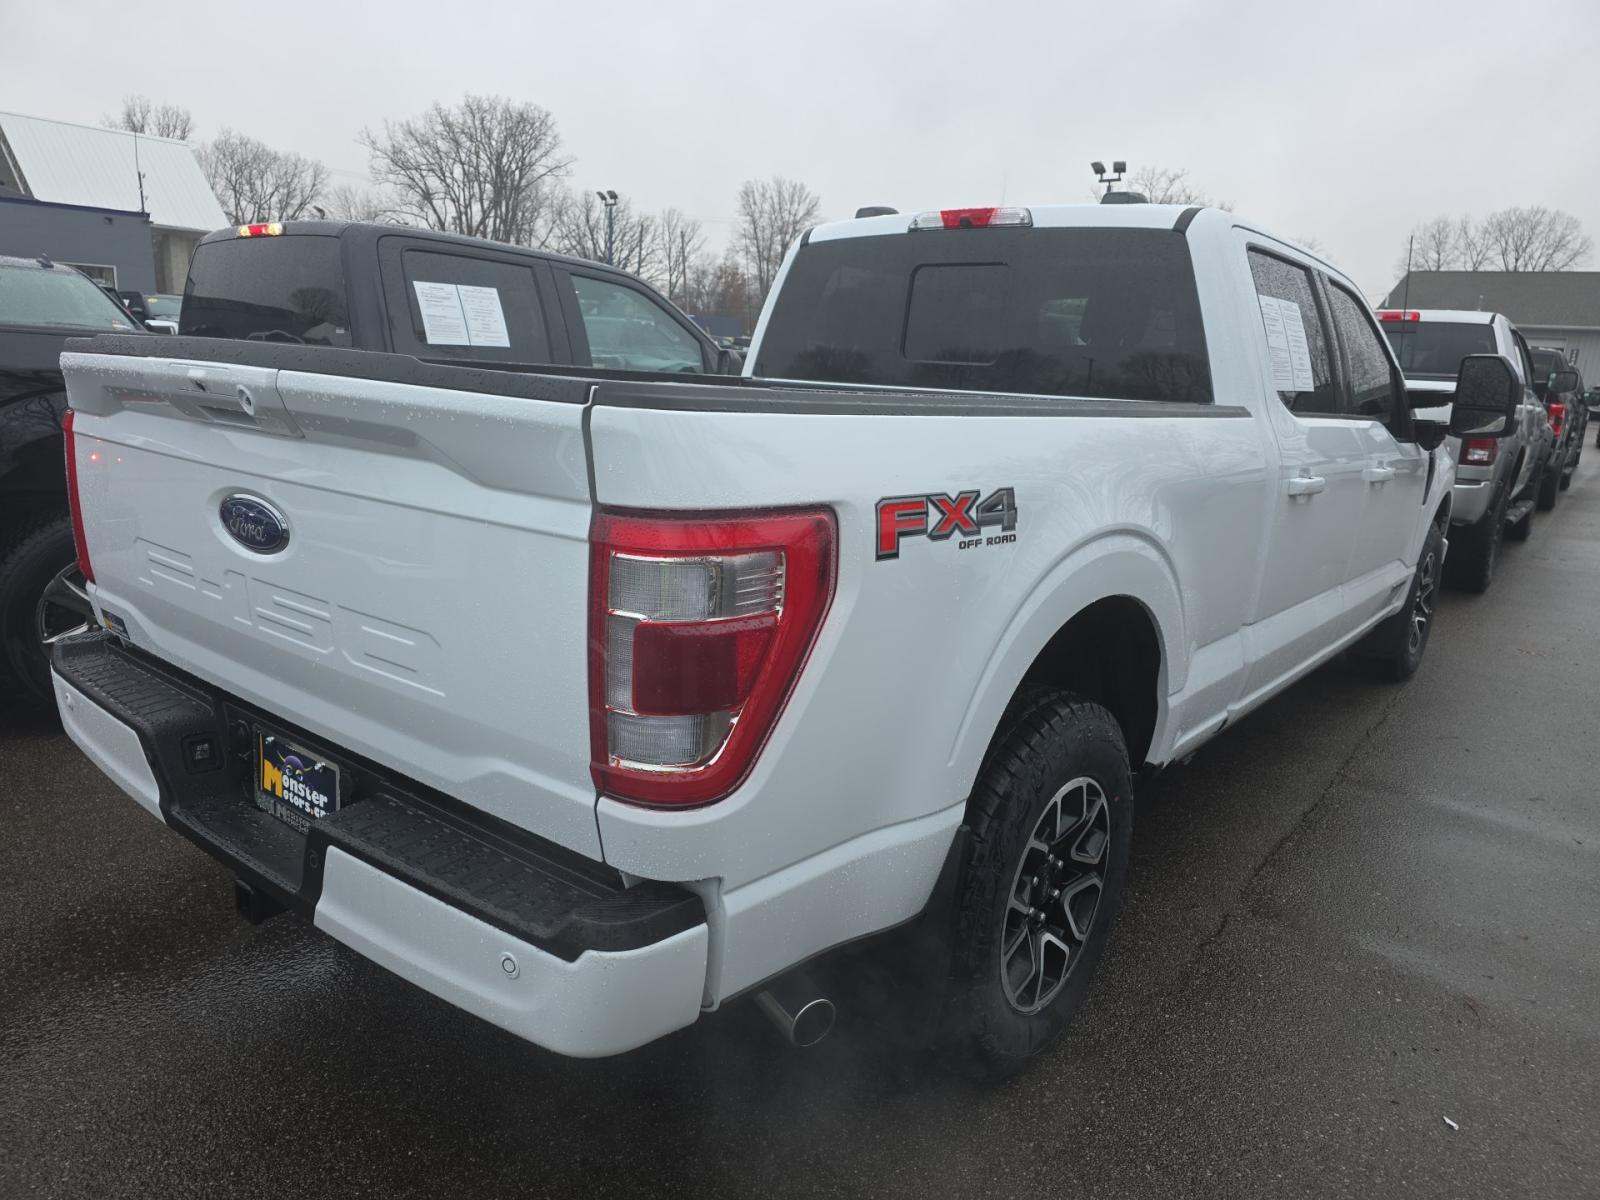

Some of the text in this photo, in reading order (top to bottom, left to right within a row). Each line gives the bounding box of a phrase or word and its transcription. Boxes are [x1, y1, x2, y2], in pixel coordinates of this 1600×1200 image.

[875, 487, 1017, 562] FX4
[959, 533, 1017, 550] OFF ROAD
[263, 759, 328, 807] Monster
